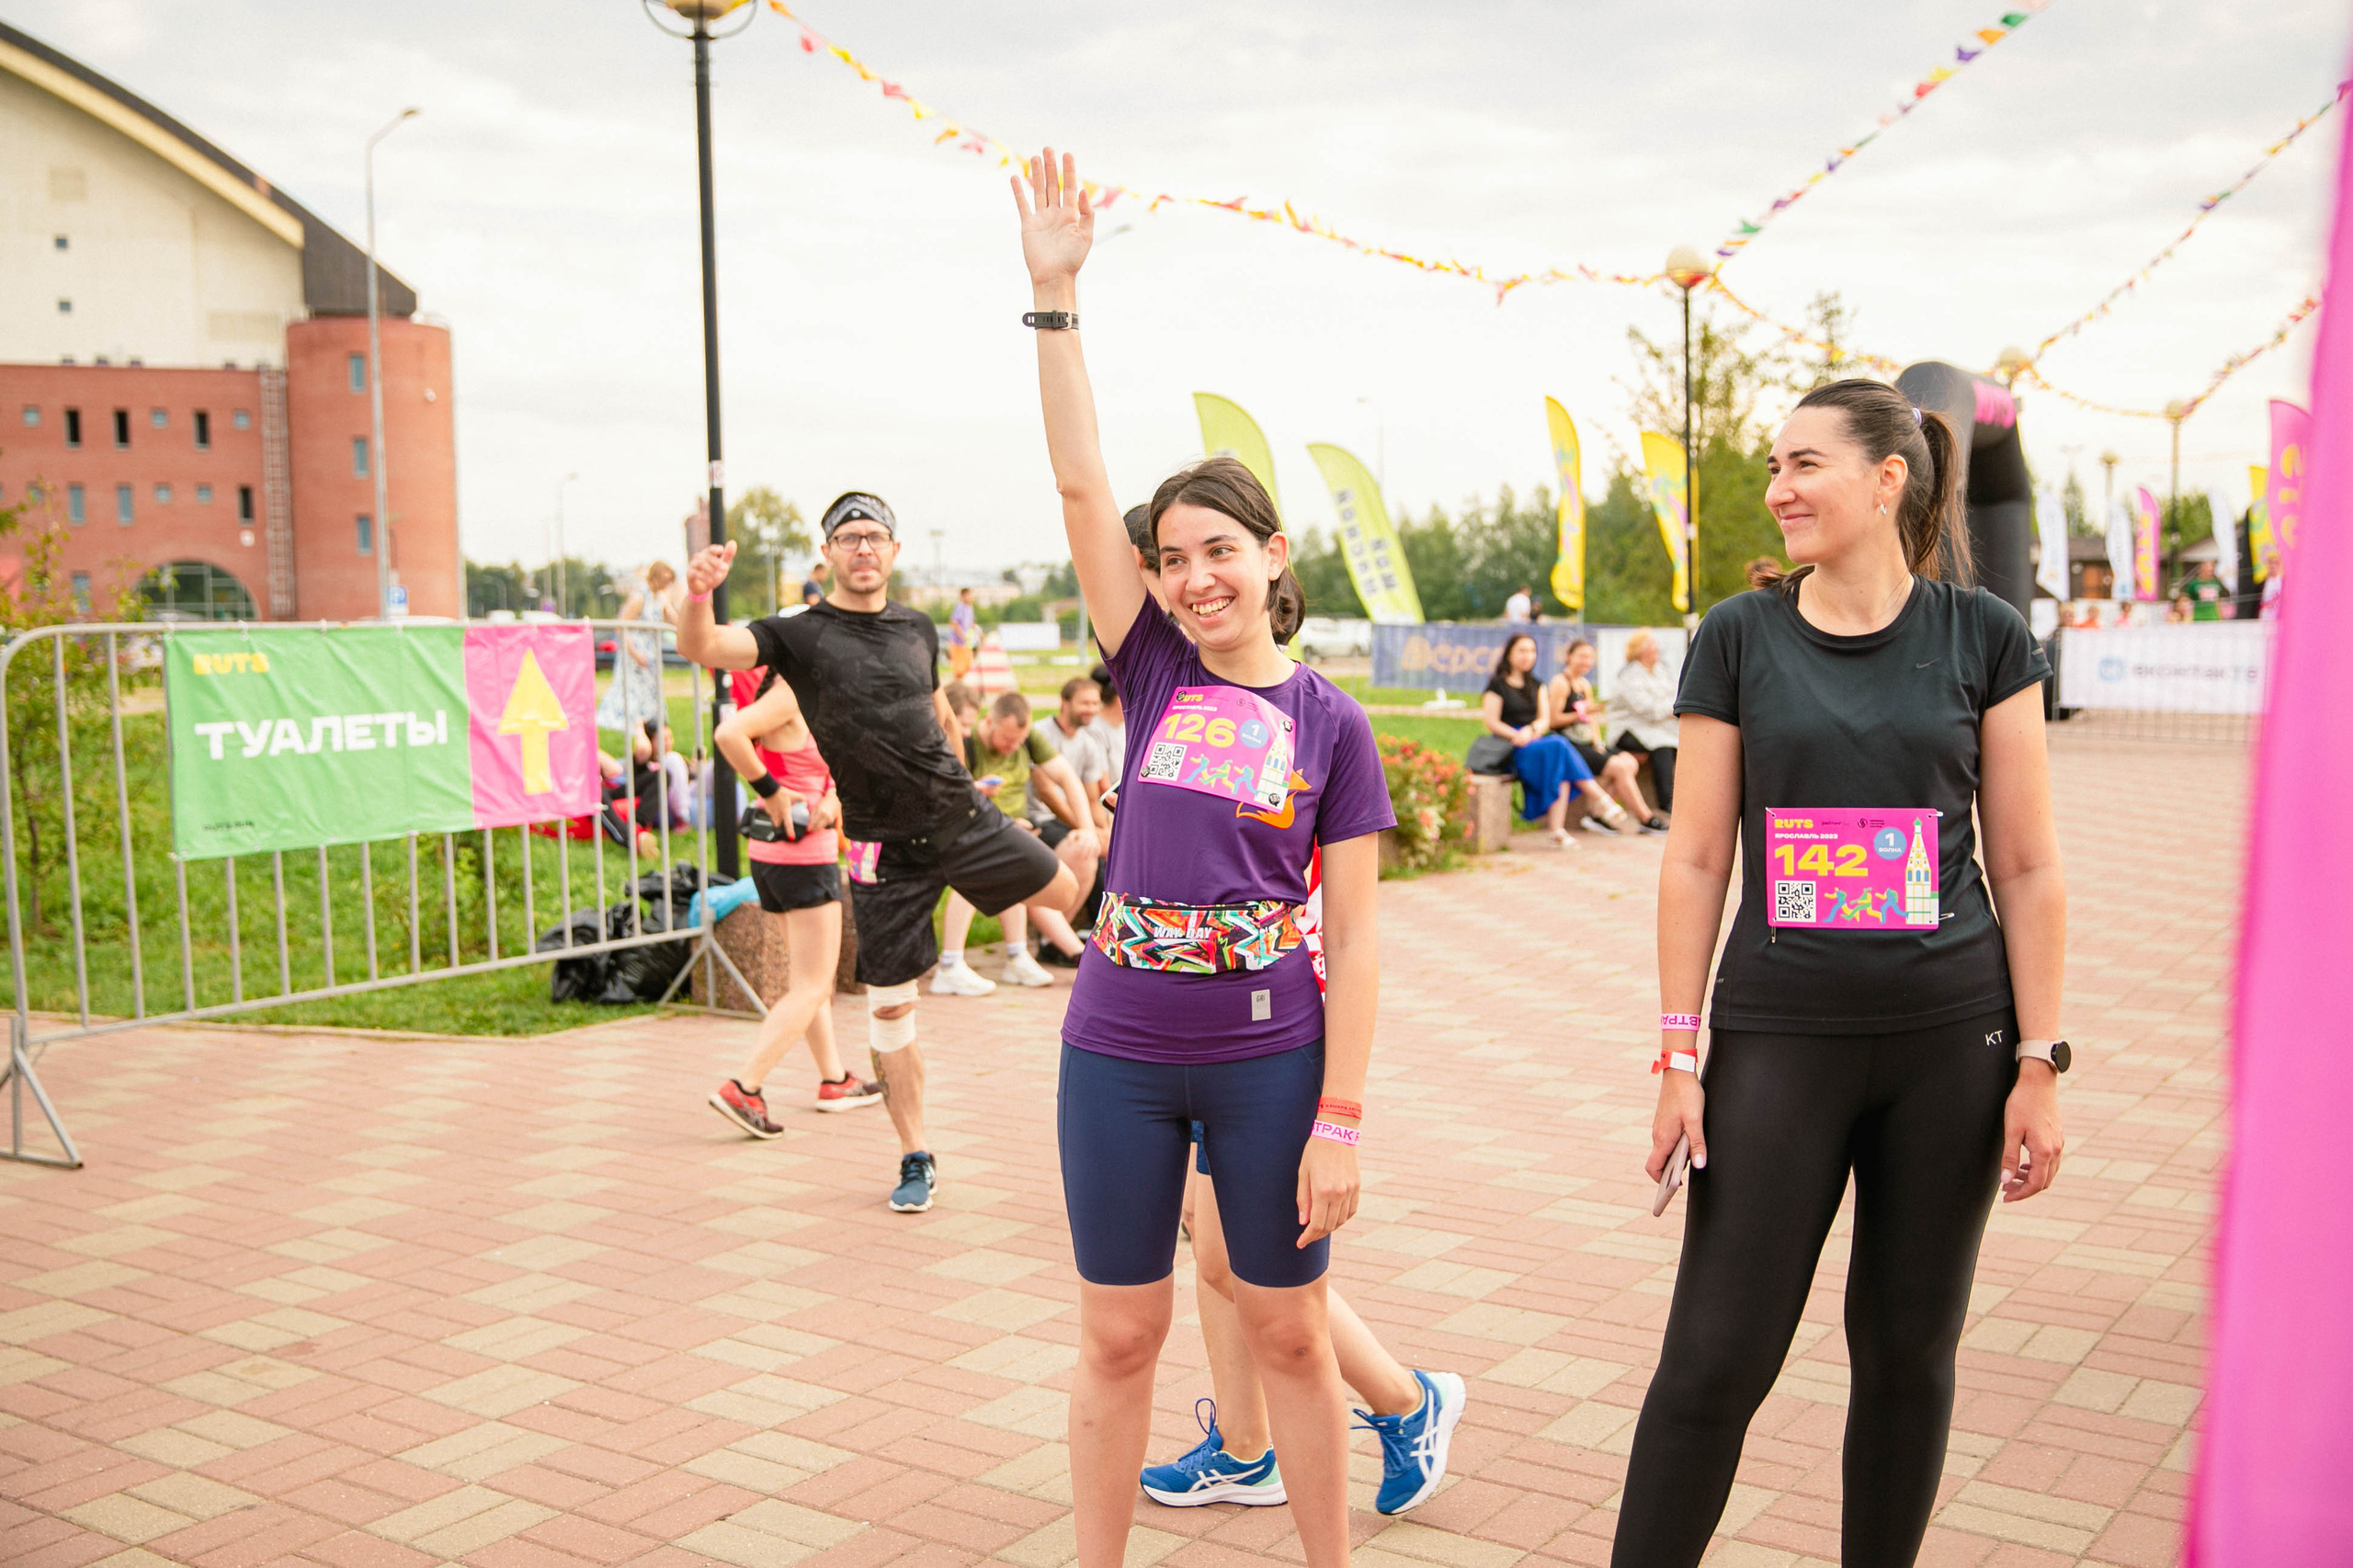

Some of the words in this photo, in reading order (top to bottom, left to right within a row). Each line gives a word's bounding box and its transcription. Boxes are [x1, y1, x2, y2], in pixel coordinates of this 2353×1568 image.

[193, 652, 270, 676] RUTS
[1176, 694, 1203, 702] UTS
[194, 710, 449, 761] ТУАЛЕТЫ
[1164, 713, 1237, 748] 126
[1251, 724, 1260, 736] 1
[1775, 819, 1813, 829] RUTS
[1884, 833, 1894, 846] 1
[1775, 844, 1869, 877] 142
[1985, 1029, 2003, 1046] KT
